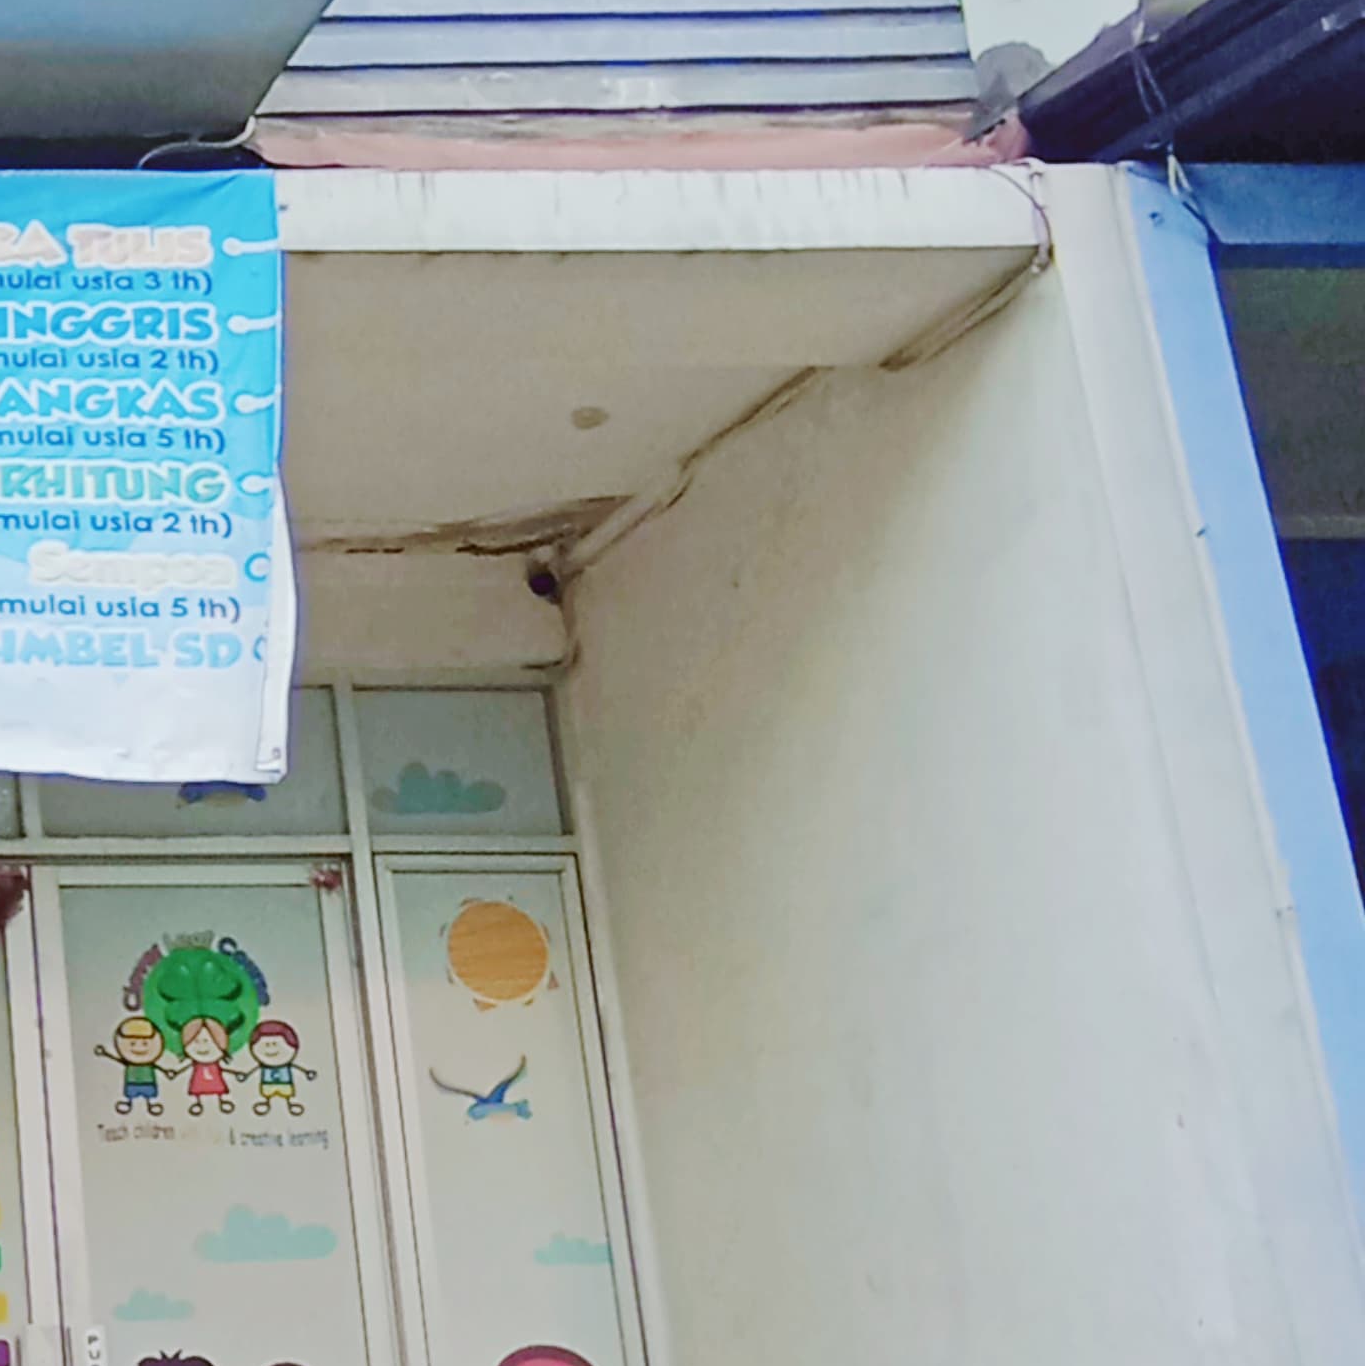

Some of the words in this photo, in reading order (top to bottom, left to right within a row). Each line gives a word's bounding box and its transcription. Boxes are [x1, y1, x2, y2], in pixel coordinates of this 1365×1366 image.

[70, 226, 210, 265] TULIS
[73, 271, 135, 291] usia
[145, 272, 161, 291] 3
[173, 270, 213, 296] th)
[77, 348, 141, 369] usia
[149, 349, 168, 369] 2
[177, 349, 219, 375] th)
[82, 426, 147, 448] usia
[155, 429, 174, 448] 5
[183, 428, 226, 455] th)
[89, 511, 153, 533] usia
[162, 512, 181, 533] 2
[189, 512, 233, 539] th)
[95, 596, 160, 618] usia
[169, 597, 189, 617] 5
[198, 597, 242, 624] th)
[173, 631, 243, 668] SD
